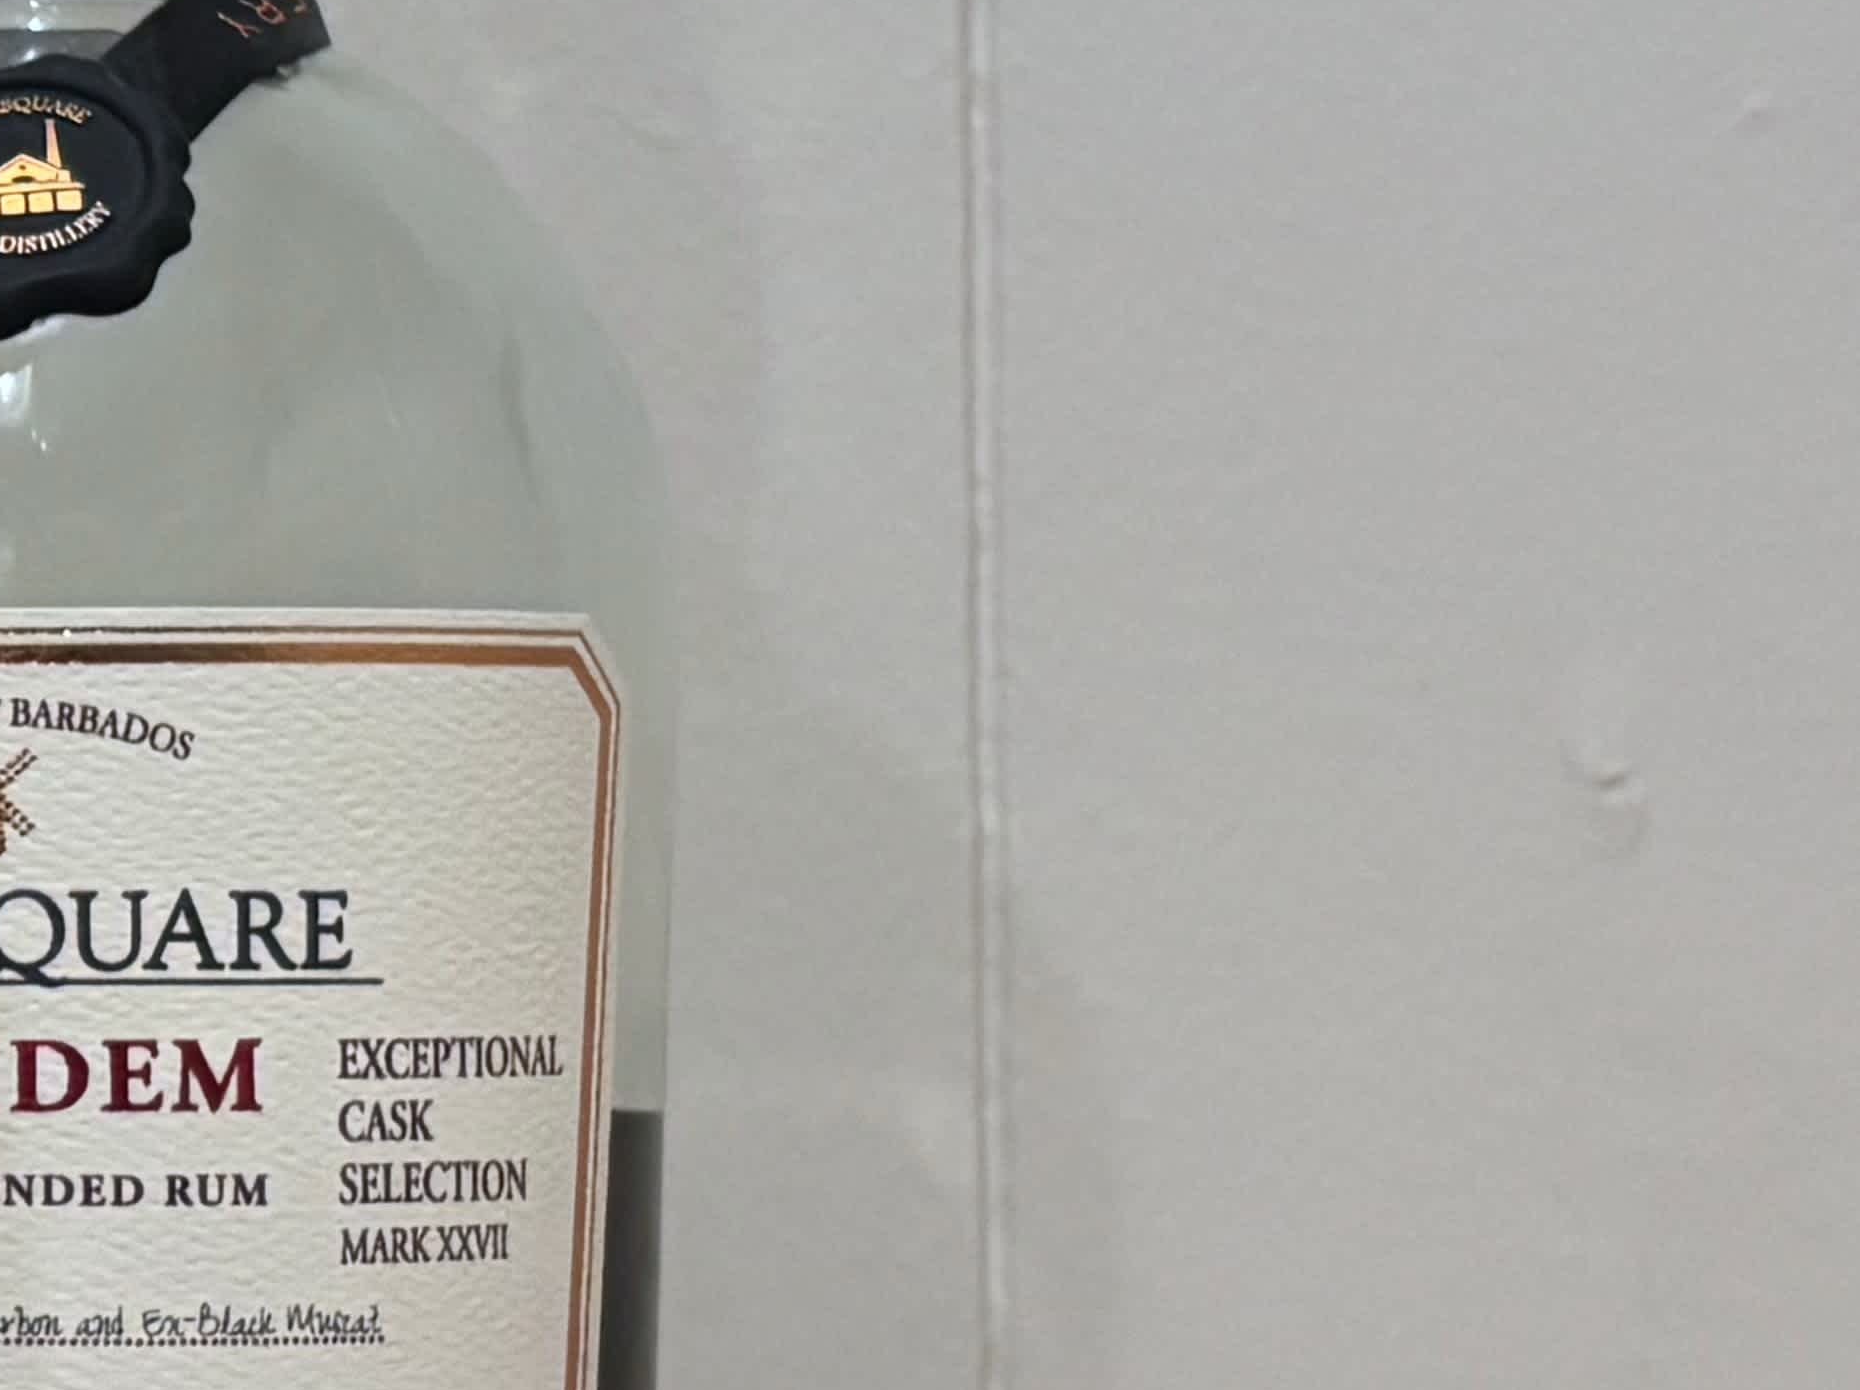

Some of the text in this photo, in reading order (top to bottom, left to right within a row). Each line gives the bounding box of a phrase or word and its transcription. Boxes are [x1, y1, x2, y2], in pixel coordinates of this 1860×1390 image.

[11, 698, 196, 761] BARBADOS
[337, 1034, 564, 1079] EXCEPTIONAL
[338, 1099, 434, 1142] CASK
[166, 1173, 269, 1206] RUM
[338, 1158, 528, 1205] SELECTION
[340, 1223, 509, 1265] MARK XXVII
[76, 1304, 124, 1336] and
[286, 1303, 383, 1335] Muscat
